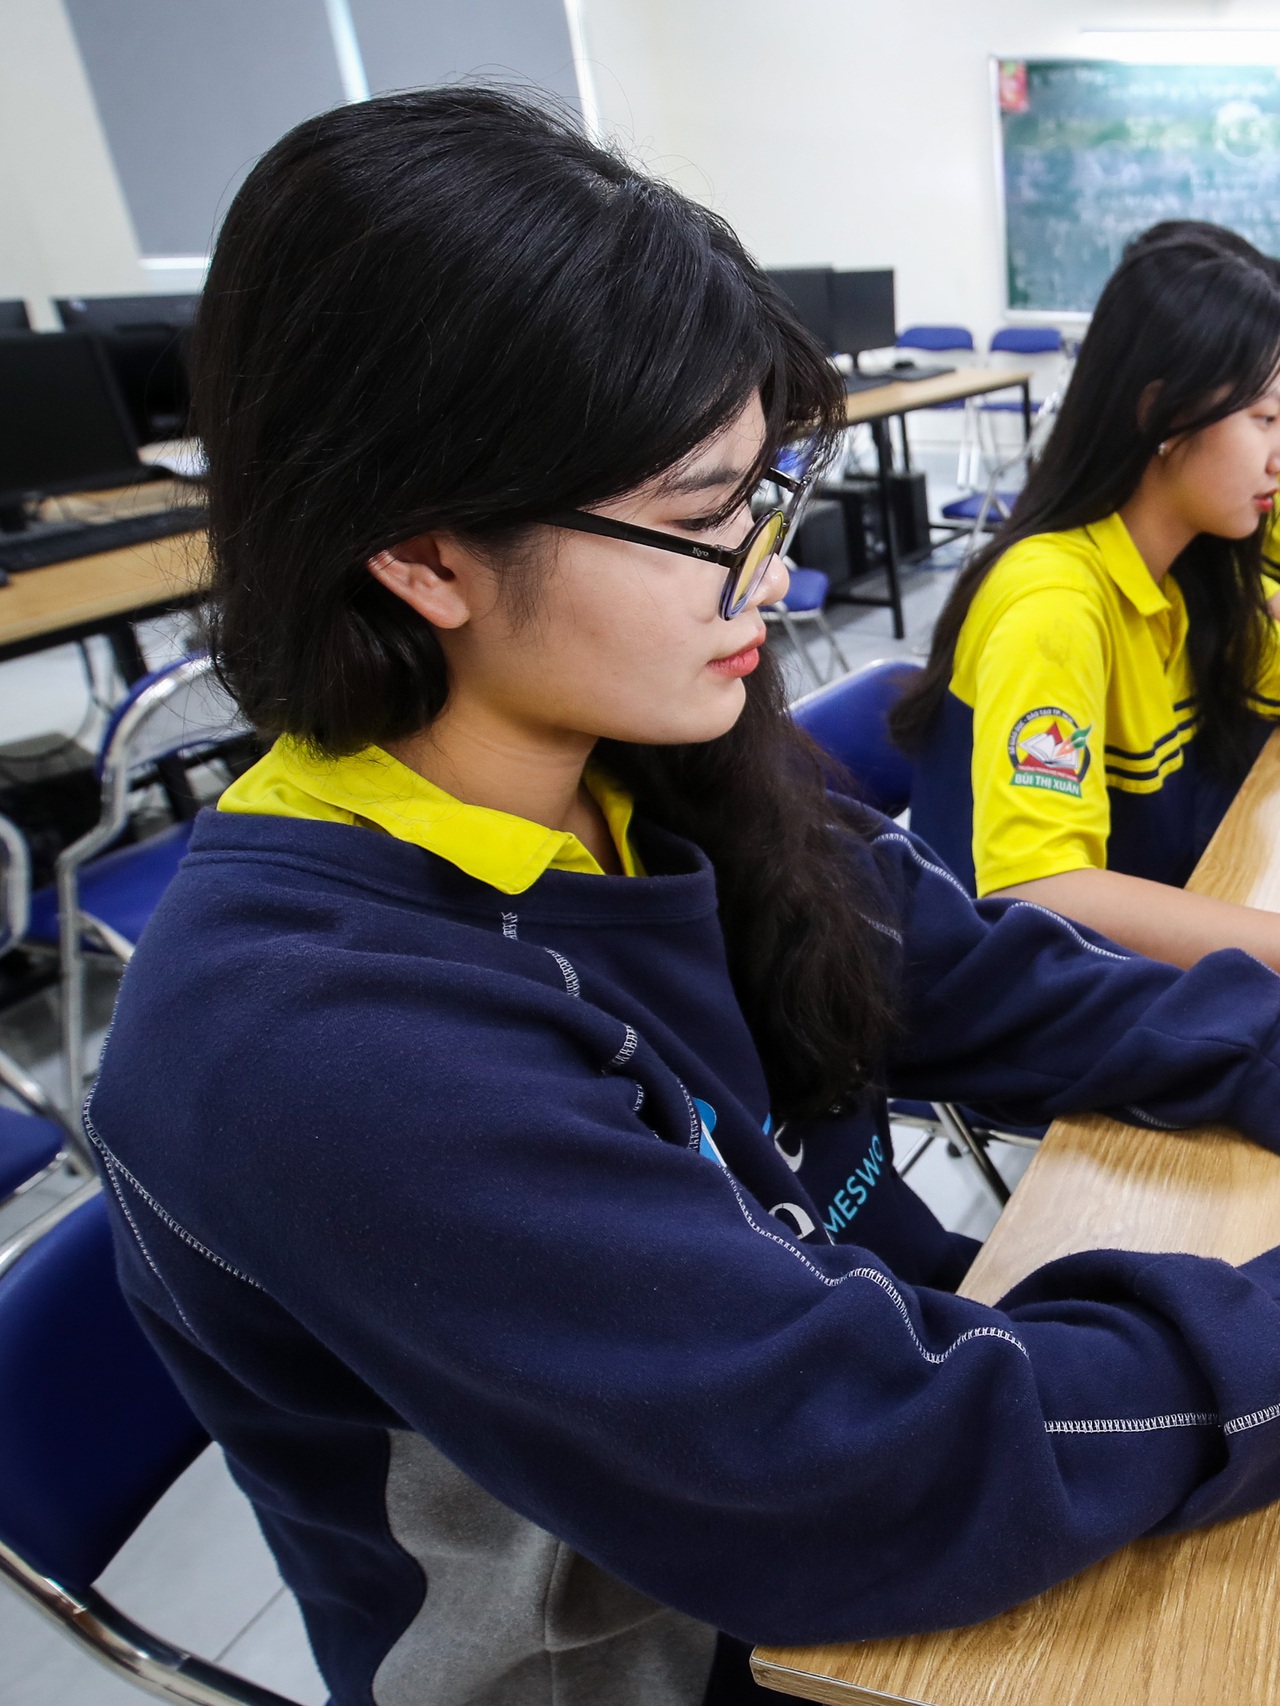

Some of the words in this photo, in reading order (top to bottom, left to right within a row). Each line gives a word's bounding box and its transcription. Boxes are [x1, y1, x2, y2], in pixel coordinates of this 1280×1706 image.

[1015, 772, 1033, 785] BÙI
[1035, 775, 1052, 789] THỊ
[1052, 779, 1080, 795] XUÂN
